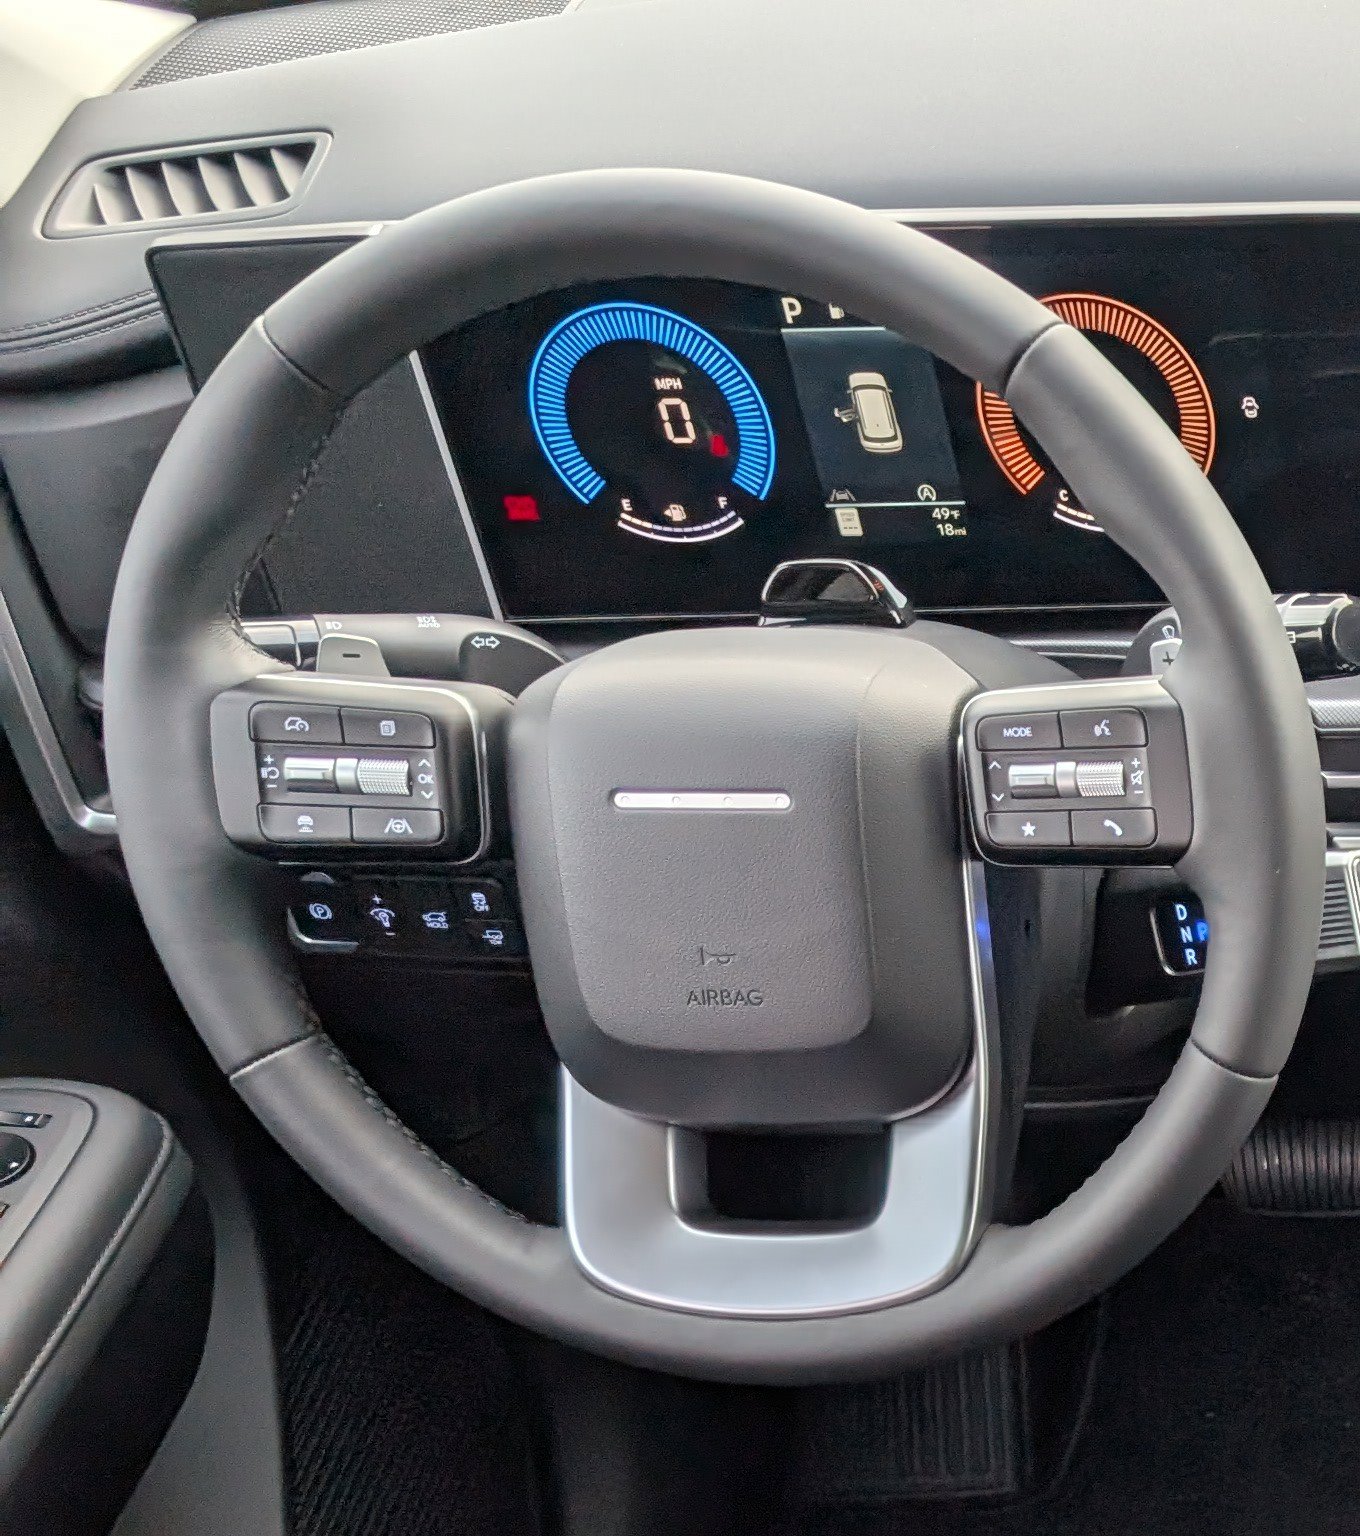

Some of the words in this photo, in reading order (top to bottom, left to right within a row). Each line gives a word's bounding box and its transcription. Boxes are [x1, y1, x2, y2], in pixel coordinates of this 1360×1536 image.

[781, 297, 802, 324] P
[655, 377, 682, 391] MPH
[658, 397, 696, 444] 0
[718, 497, 728, 509] F
[1058, 490, 1069, 502] C
[621, 498, 633, 512] E
[1003, 726, 1033, 738] MODE
[418, 773, 434, 784] OK
[1175, 903, 1188, 920] D
[1180, 925, 1193, 943] N
[1184, 948, 1198, 965] R
[687, 988, 763, 1006] AIRBAG
